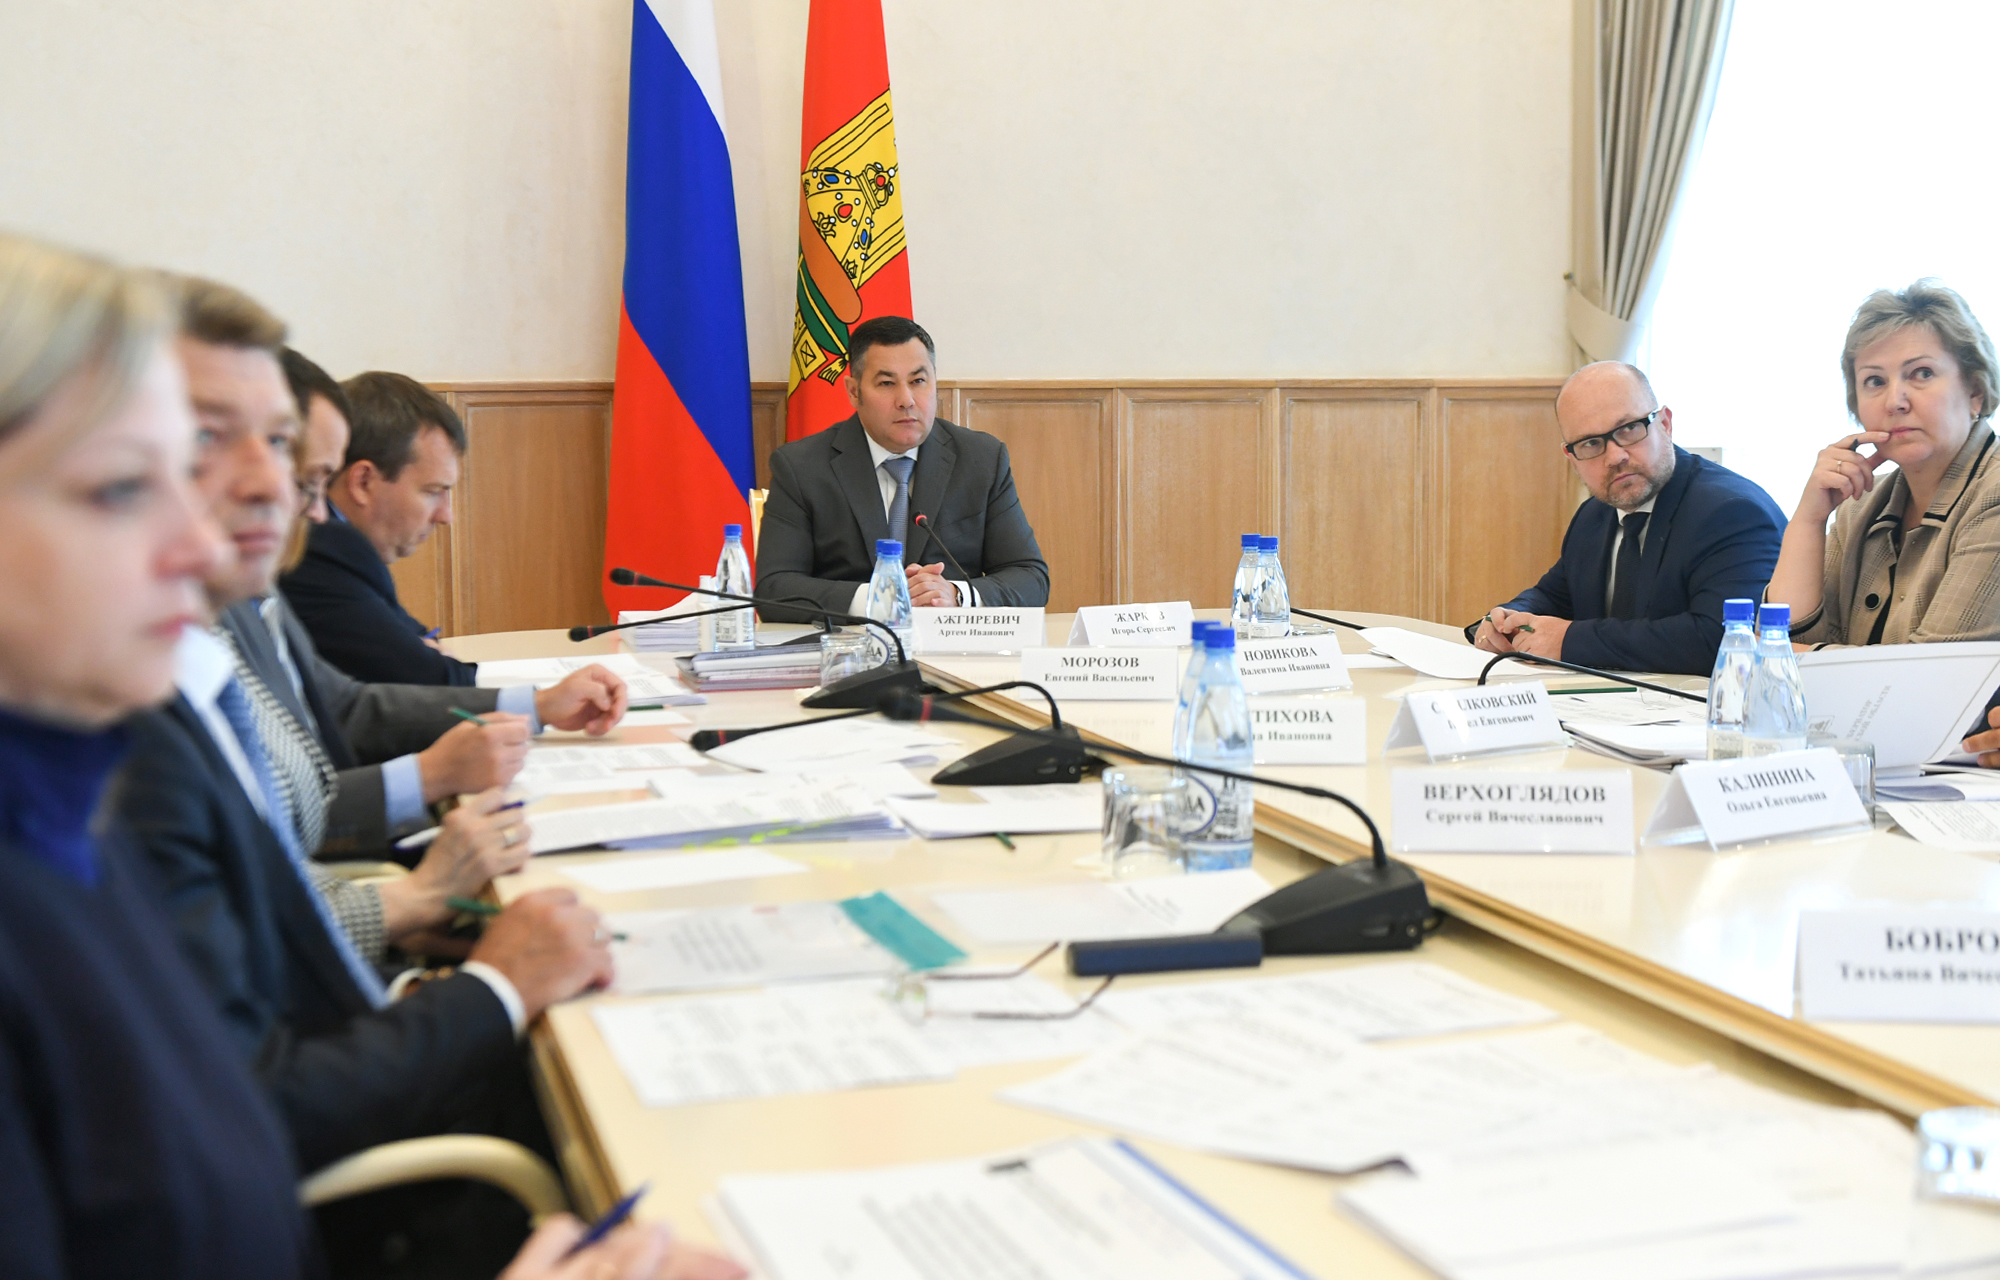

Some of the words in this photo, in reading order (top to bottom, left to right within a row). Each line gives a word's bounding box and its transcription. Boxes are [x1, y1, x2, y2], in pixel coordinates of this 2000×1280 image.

[934, 615, 1021, 626] АЖГИРЕВИЧ
[1114, 611, 1165, 623] ЖАРКВ
[938, 628, 967, 638] Артем
[969, 628, 1015, 637] Иванович
[1111, 627, 1135, 636] Игорь
[1244, 646, 1318, 662] НОВИКОВА
[1061, 656, 1140, 668] МОРОЗОВ
[1240, 665, 1287, 676] Валентина
[1289, 662, 1331, 674] Ивановна
[1044, 671, 1089, 683] Евгений
[1091, 672, 1155, 683] Васильевич
[1431, 690, 1537, 714] СЛКОВСКИЙ
[1248, 709, 1334, 723] ТИХОВА
[1479, 713, 1535, 727] Евгеньевич
[1268, 730, 1333, 741] Ивановна
[1718, 766, 1816, 793] КАЛИНИНА
[1423, 784, 1607, 805] ВЕРХОГЛЯДОВ
[1727, 800, 1763, 814] Ольга
[1763, 790, 1828, 810] Евгеньевна
[1426, 808, 1482, 825] Сергей
